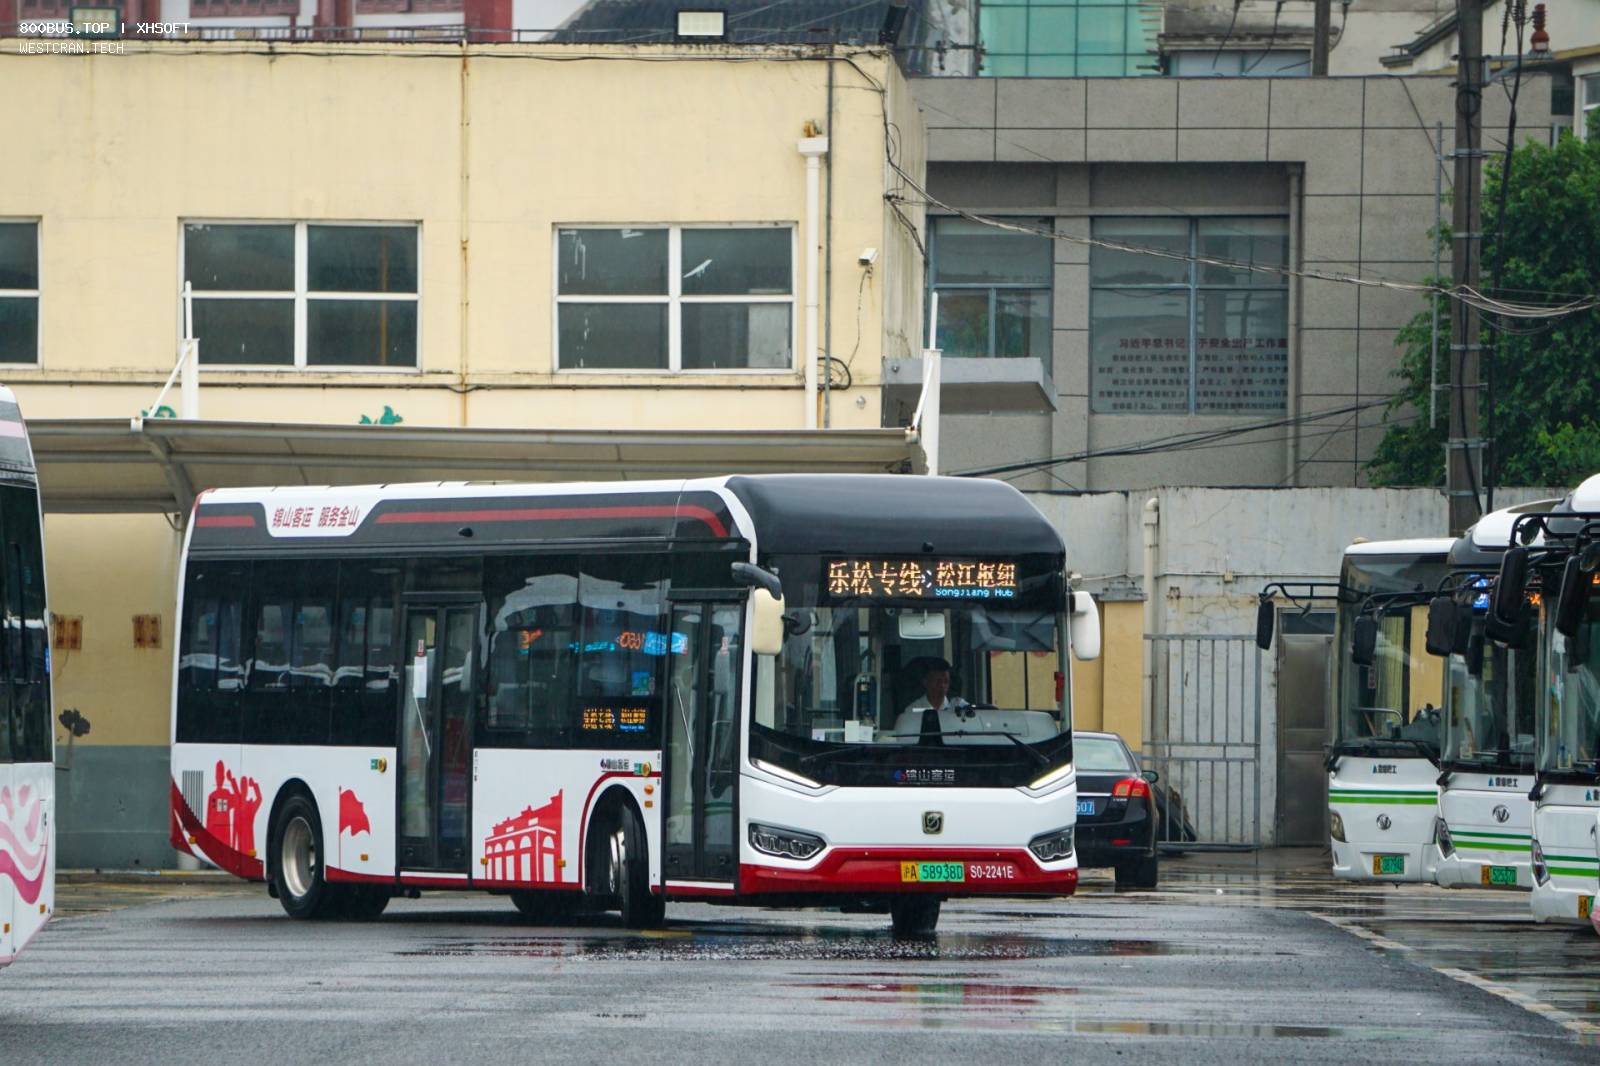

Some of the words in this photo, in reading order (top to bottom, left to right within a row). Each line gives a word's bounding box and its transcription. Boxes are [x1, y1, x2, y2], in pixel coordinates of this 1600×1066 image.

[317, 505, 360, 528] 服务金山
[828, 562, 922, 596] 乐松专线
[936, 562, 1016, 588] 松江枢纽
[994, 588, 1014, 597] Hub
